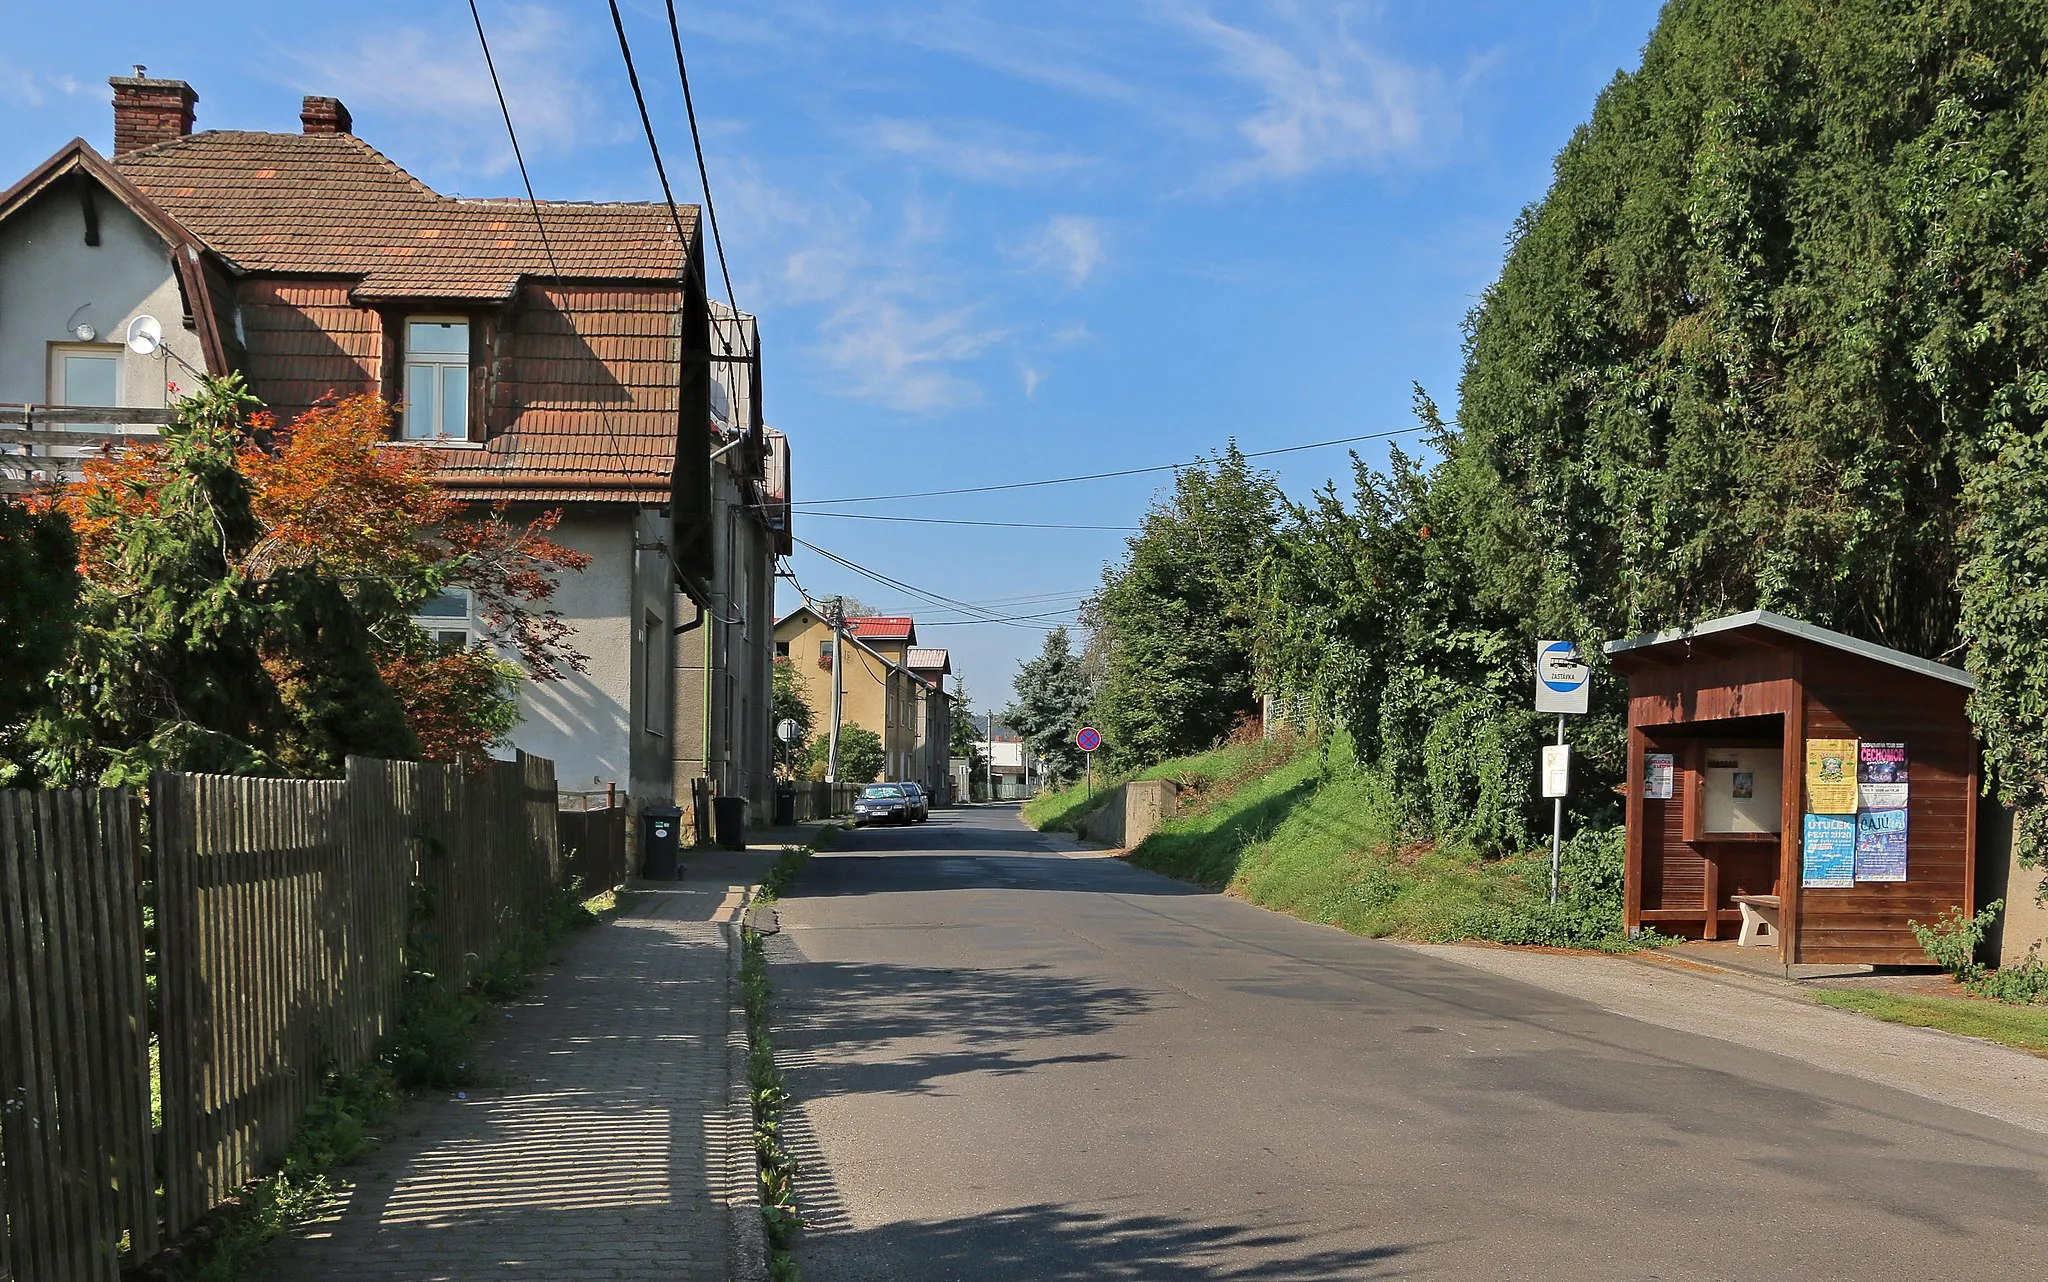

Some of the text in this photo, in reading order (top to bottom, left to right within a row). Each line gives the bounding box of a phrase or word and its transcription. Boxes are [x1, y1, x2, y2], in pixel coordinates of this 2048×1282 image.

[1551, 672, 1575, 680] ZASTÁVKA
[1808, 831, 1852, 839] FEST 2020
